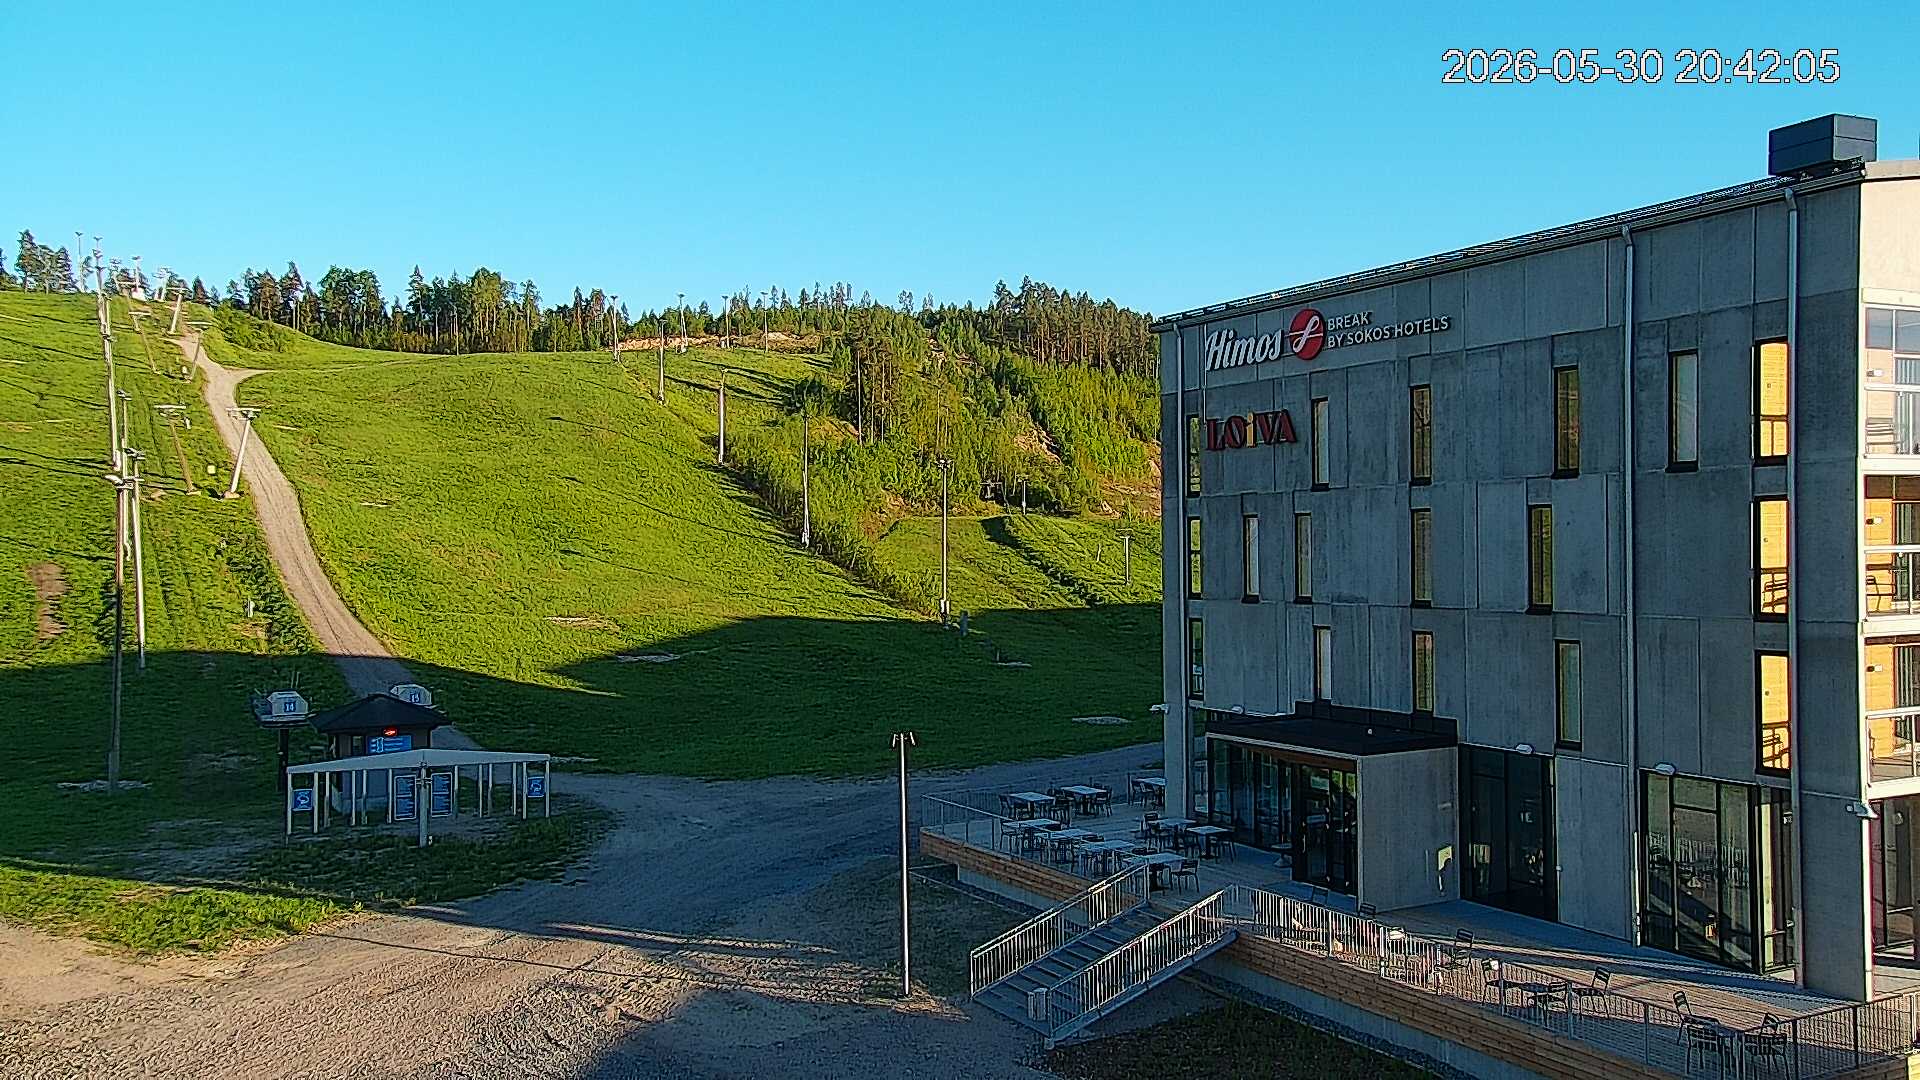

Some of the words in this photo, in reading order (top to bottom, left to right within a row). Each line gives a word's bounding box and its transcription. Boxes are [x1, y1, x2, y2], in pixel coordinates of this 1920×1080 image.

[1327, 312, 1370, 331] BREAK
[1327, 332, 1345, 349] BY
[1347, 325, 1391, 344] SOKOS
[1393, 316, 1450, 337] HOTELS
[1205, 328, 1282, 371] Himos
